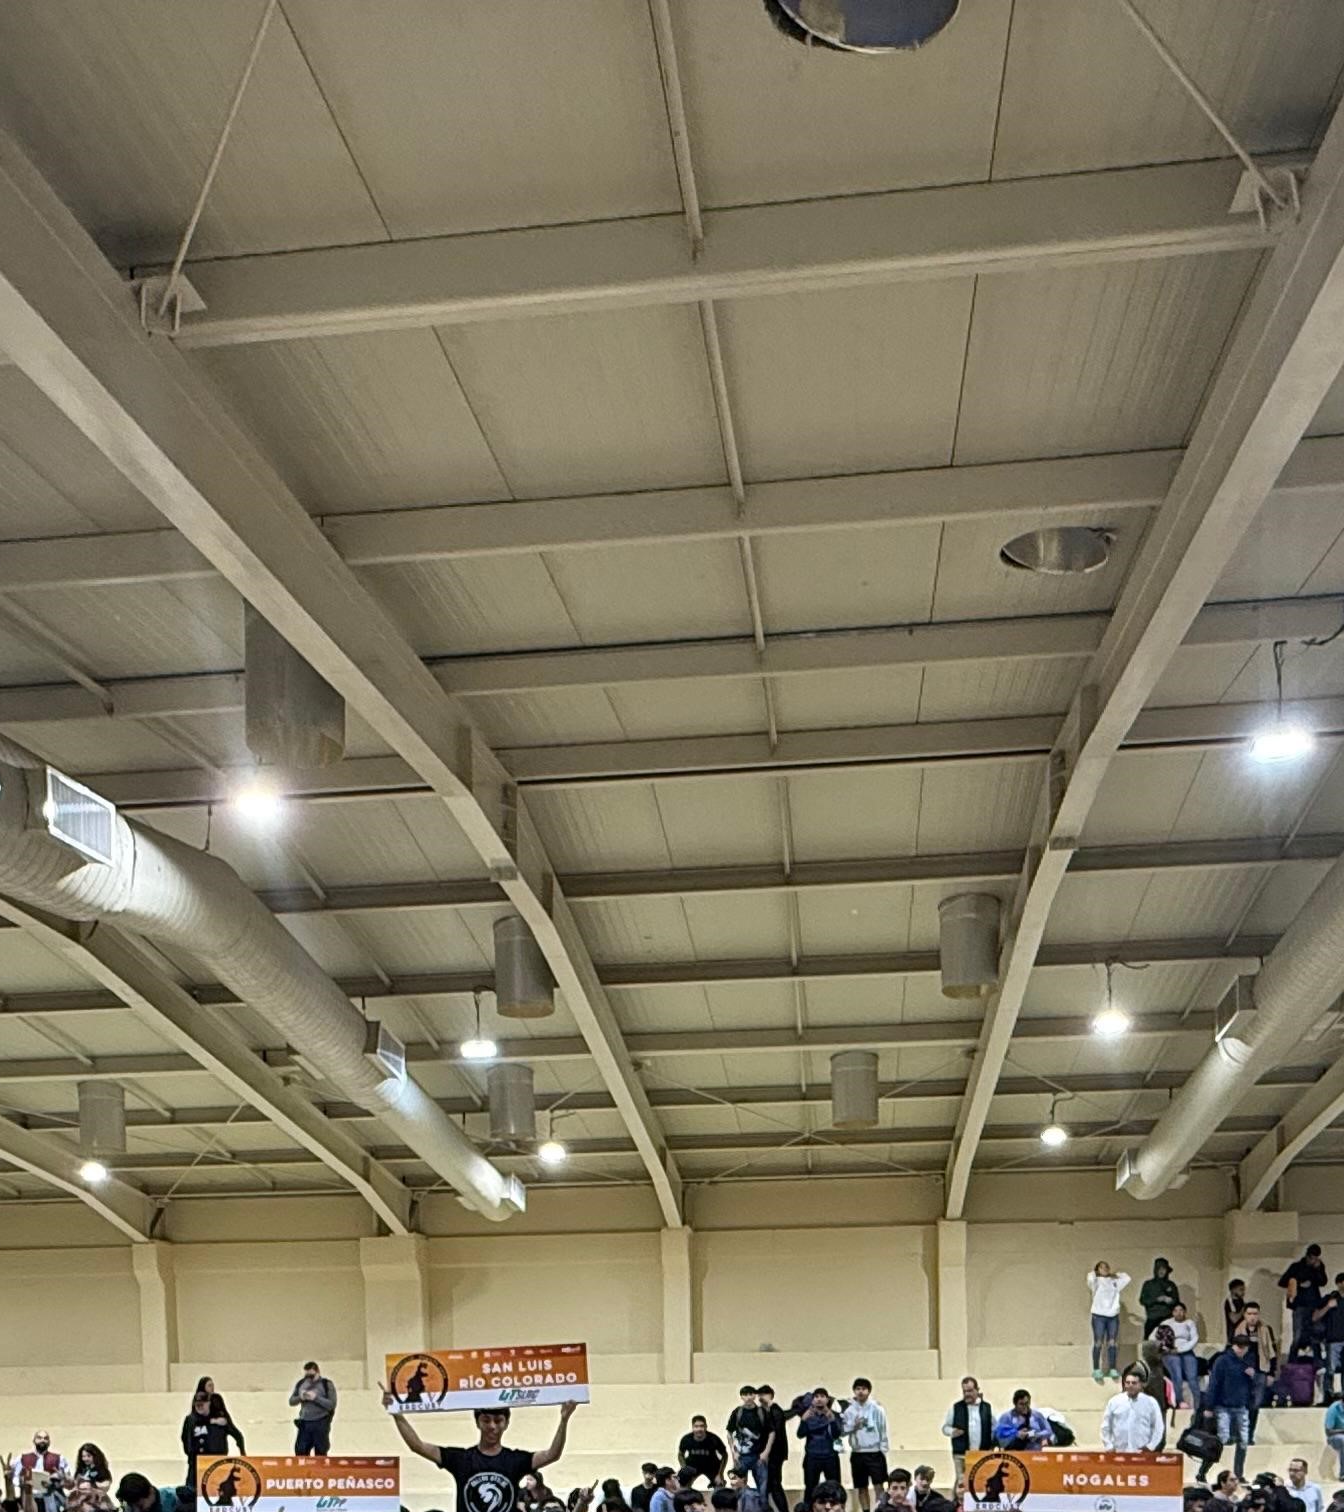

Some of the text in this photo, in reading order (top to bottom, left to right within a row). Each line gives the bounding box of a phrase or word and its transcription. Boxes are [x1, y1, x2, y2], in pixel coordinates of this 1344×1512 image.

[481, 1359, 553, 1375] SAN LUIS
[459, 1372, 578, 1390] RÍO COLORADO
[266, 1475, 395, 1490] PUERTO PEÑASCO
[1062, 1473, 1151, 1487] NOGALES
